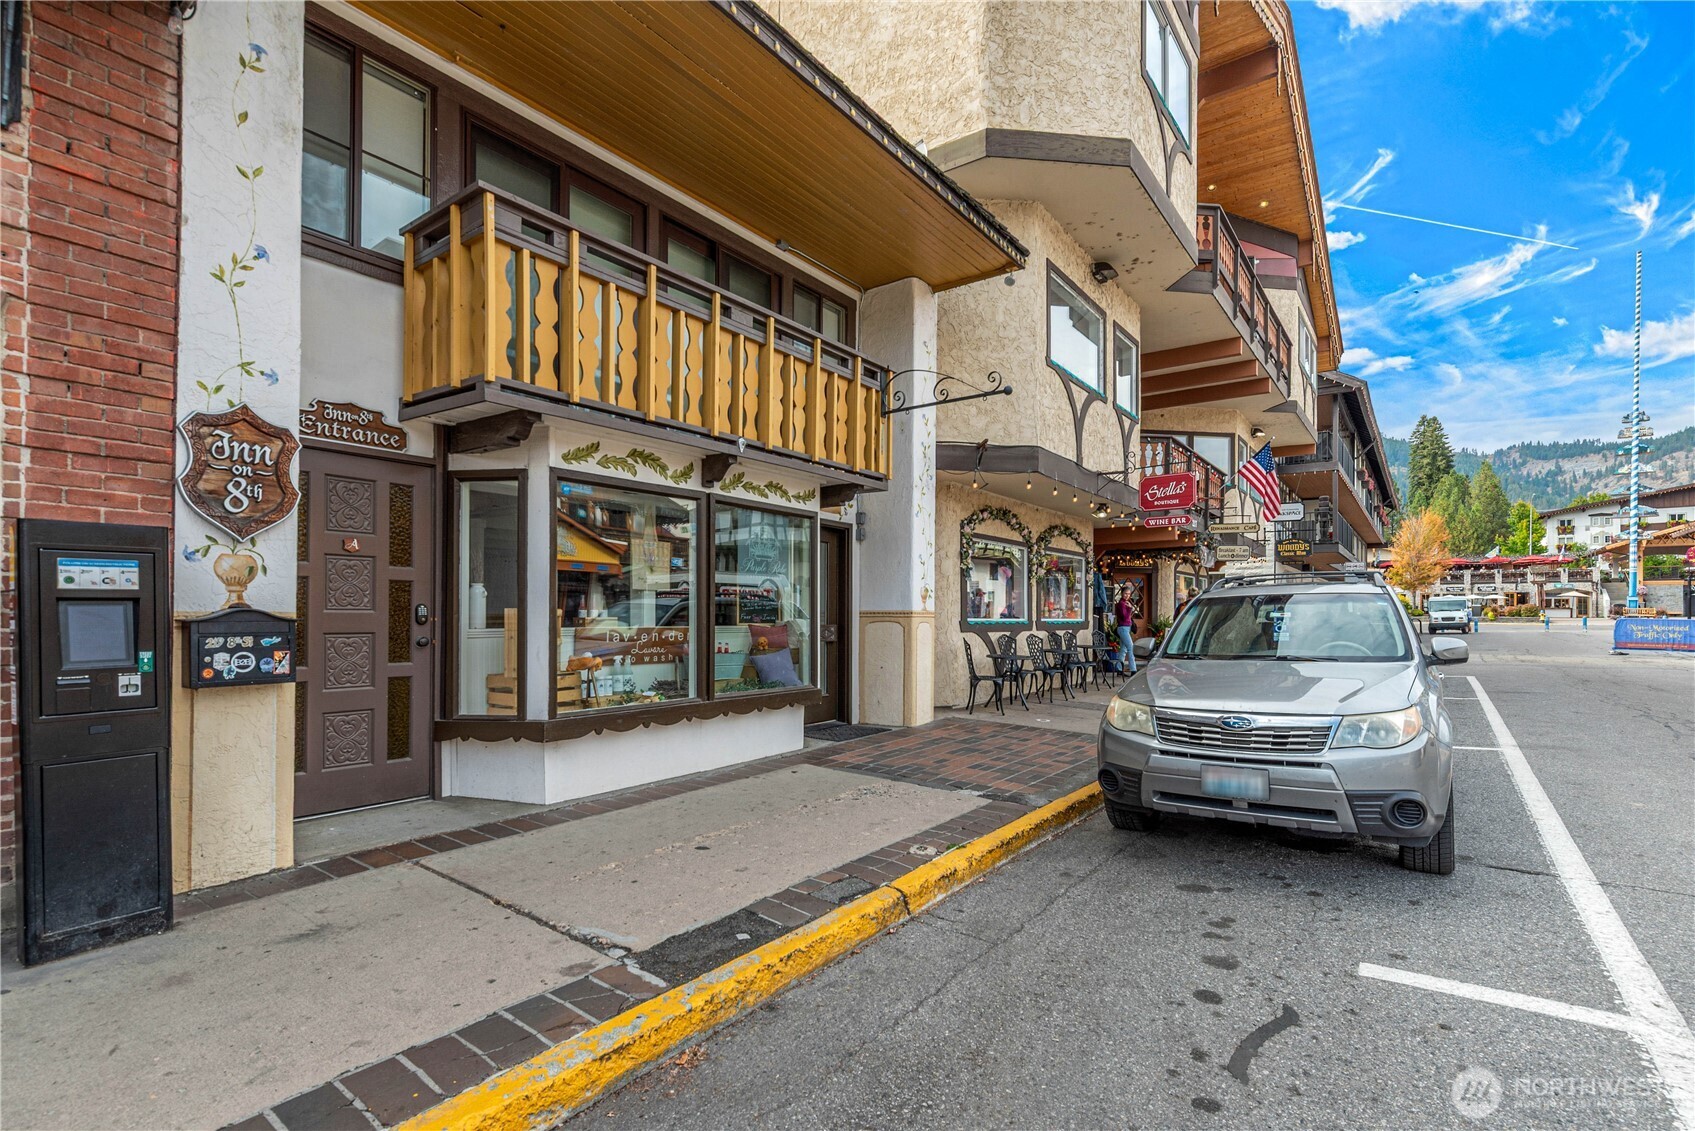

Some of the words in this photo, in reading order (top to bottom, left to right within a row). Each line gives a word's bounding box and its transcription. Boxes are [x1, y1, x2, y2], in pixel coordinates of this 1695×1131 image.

[323, 404, 352, 423] Inn
[358, 410, 373, 425] 8th
[299, 412, 401, 448] Entrance
[210, 429, 276, 466] Inn
[231, 463, 254, 477] on
[223, 477, 263, 514] 8th
[1148, 518, 1169, 526] WINE
[1171, 517, 1187, 525] BAR
[643, 654, 673, 662] wash
